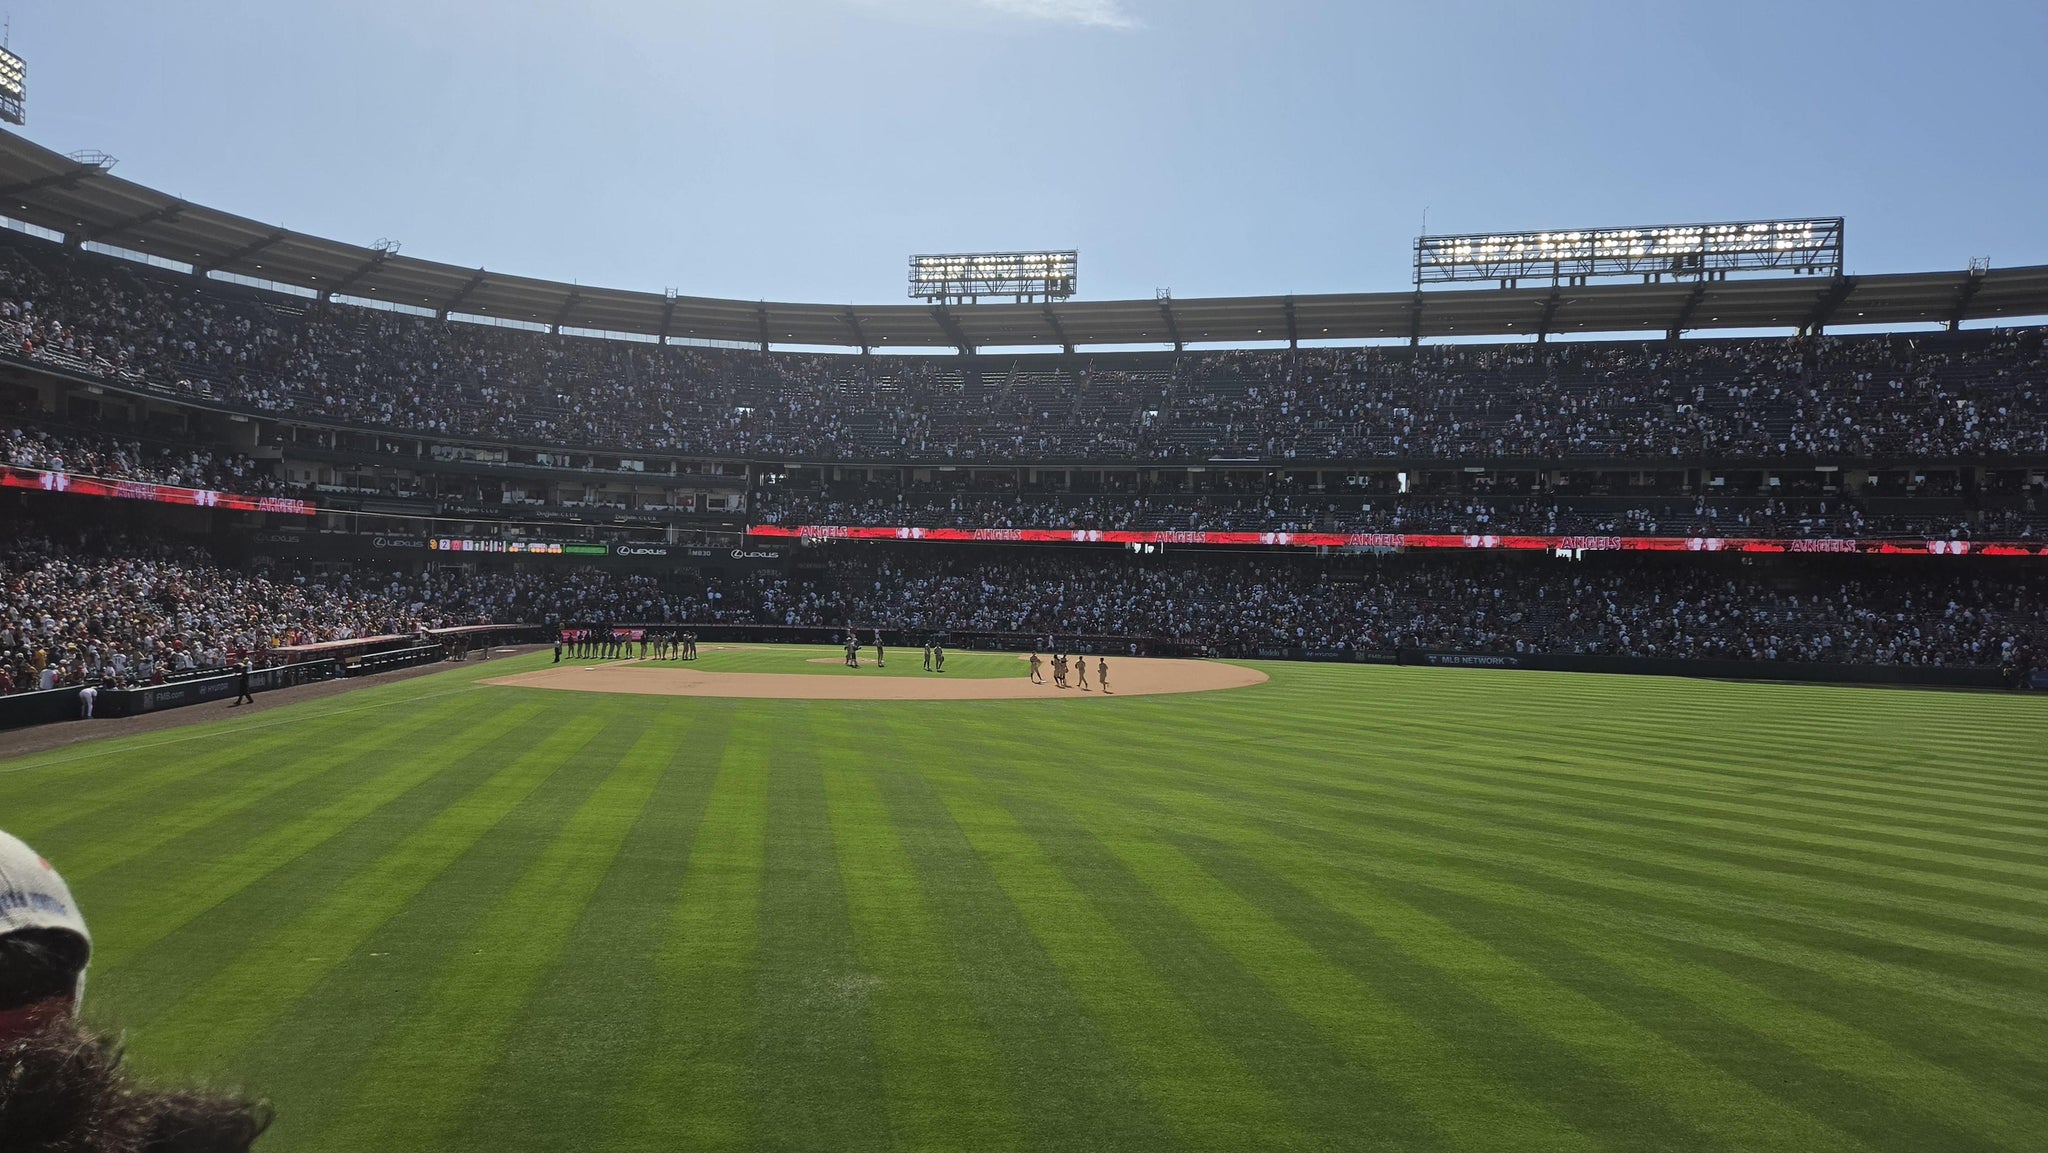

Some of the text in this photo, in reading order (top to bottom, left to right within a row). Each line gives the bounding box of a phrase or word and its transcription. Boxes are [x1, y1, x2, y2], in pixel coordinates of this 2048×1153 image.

[801, 526, 848, 538] ANGELS
[975, 529, 1021, 541] ANGELS
[1156, 531, 1206, 543] ANGELS
[387, 540, 424, 548] LEXUS
[1349, 533, 1405, 547] ANGELS
[1561, 536, 1621, 550] ANGELS
[1791, 539, 1856, 553] ANGELS
[630, 548, 667, 556] LEXUS
[743, 551, 780, 559] LEXUS
[1441, 656, 1505, 665] MLB NETWORK
